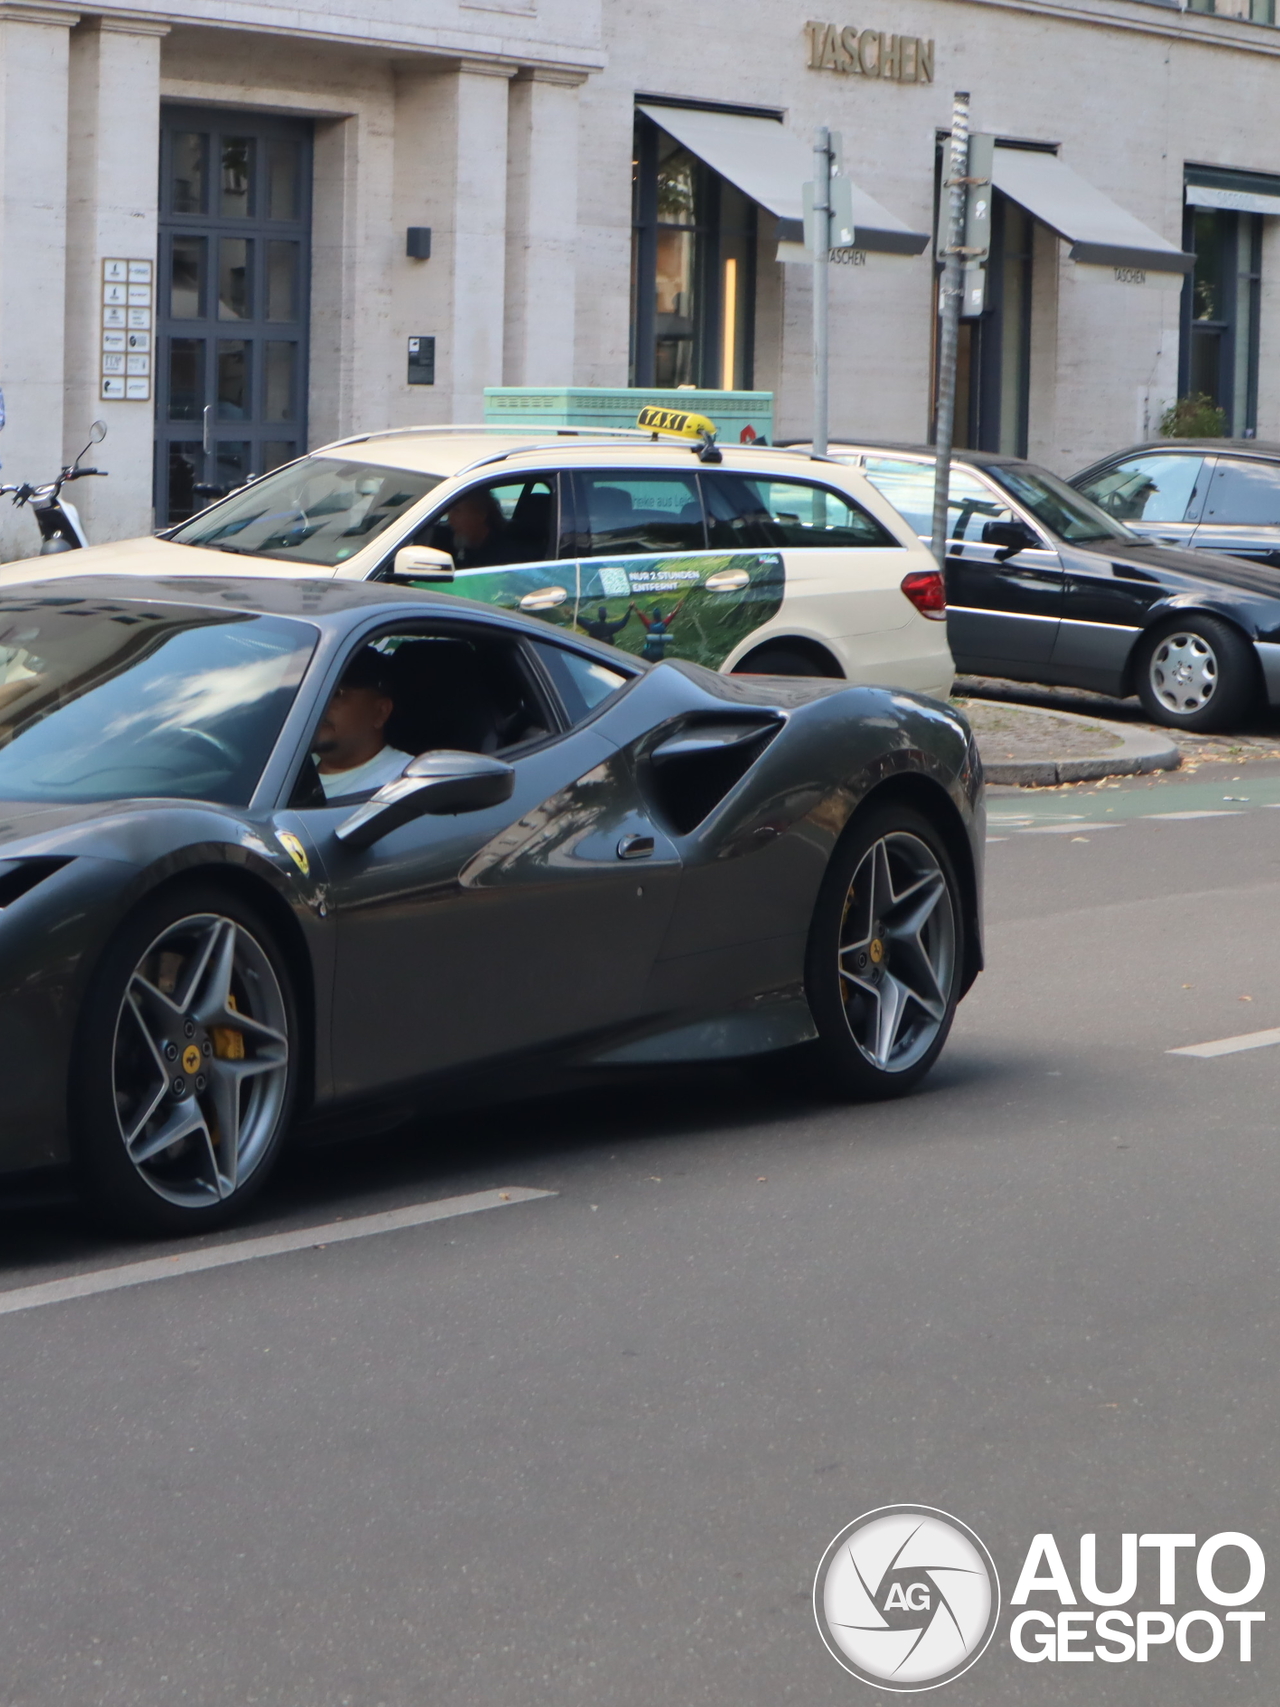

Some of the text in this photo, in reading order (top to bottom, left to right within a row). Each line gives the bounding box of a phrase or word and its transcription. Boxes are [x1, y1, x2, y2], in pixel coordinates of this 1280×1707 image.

[805, 20, 935, 83] TASCHEN
[1114, 267, 1146, 285] TASCHEN
[644, 409, 683, 431] TAXI
[629, 572, 649, 581] NUR
[657, 571, 700, 581] STUNDEN
[632, 582, 678, 592] ENTFERNT
